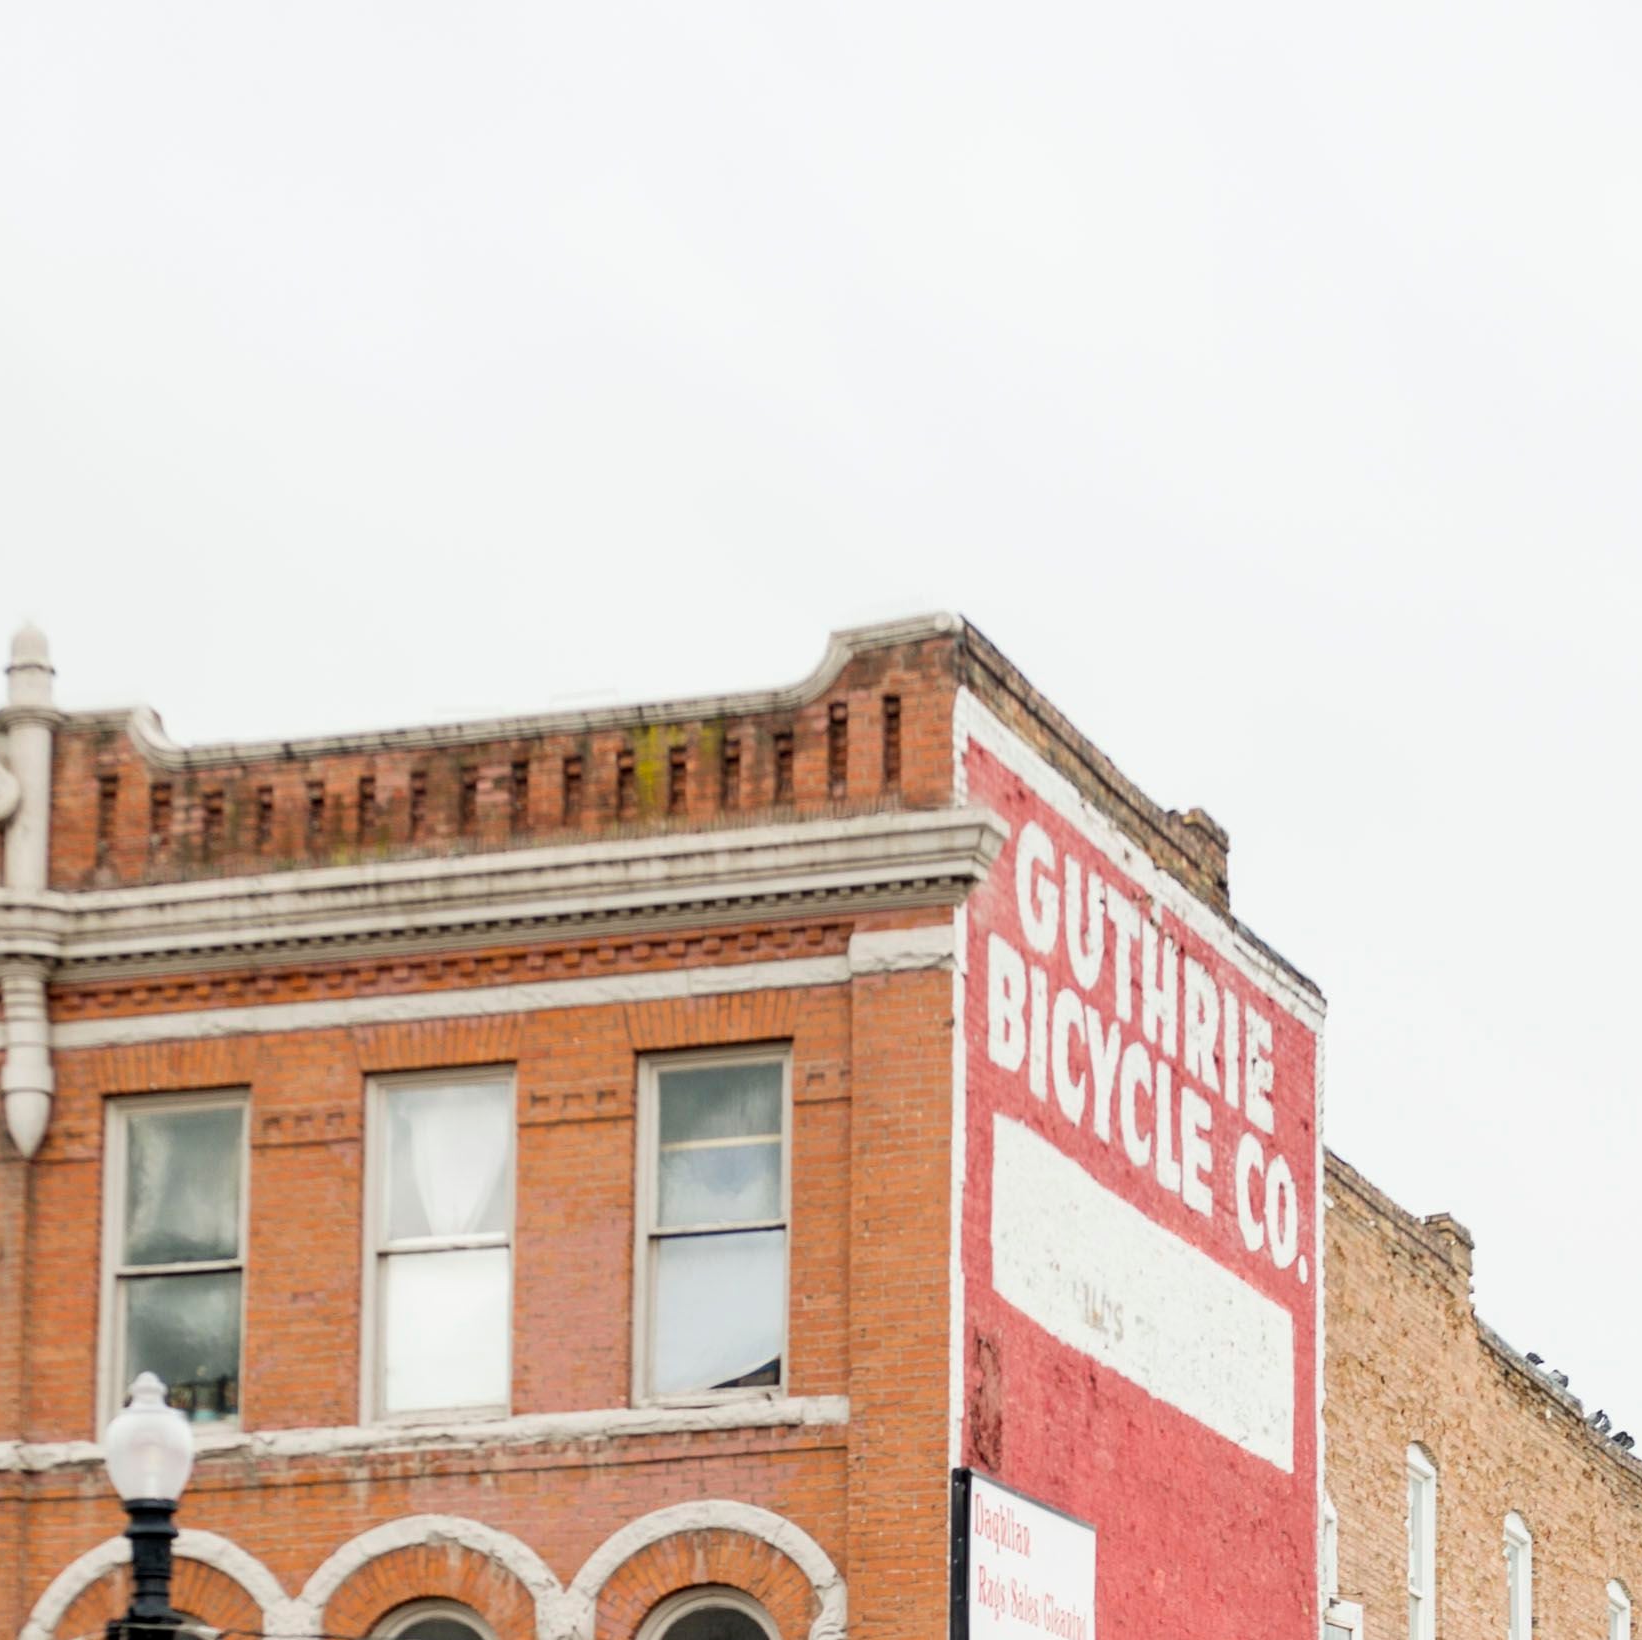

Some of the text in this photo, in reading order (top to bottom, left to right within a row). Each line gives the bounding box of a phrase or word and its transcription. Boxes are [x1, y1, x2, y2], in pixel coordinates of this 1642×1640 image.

[987, 932, 1309, 1284] BICYCLE CO.
[1014, 820, 1275, 1134] GUTHRIE
